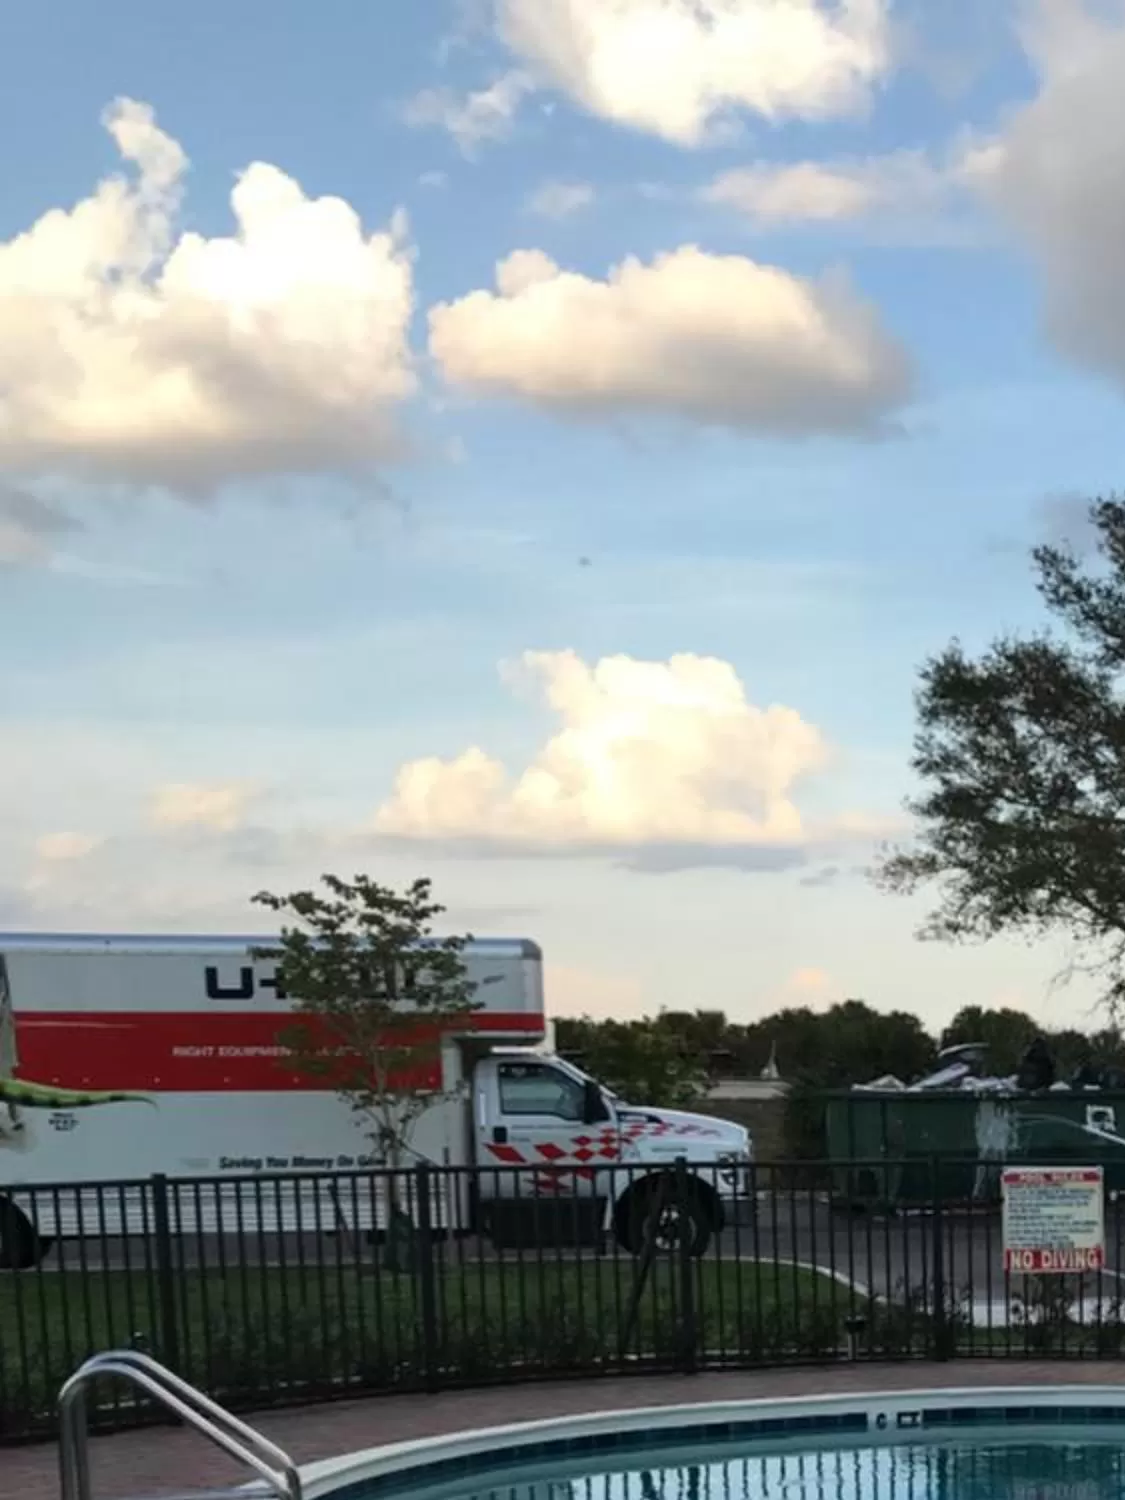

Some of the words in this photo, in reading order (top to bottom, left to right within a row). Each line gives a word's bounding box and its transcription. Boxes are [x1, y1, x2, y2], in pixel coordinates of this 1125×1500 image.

[172, 1045, 213, 1057] RIGHT
[1010, 1250, 1034, 1269] NO
[1041, 1249, 1098, 1268] DIVING
